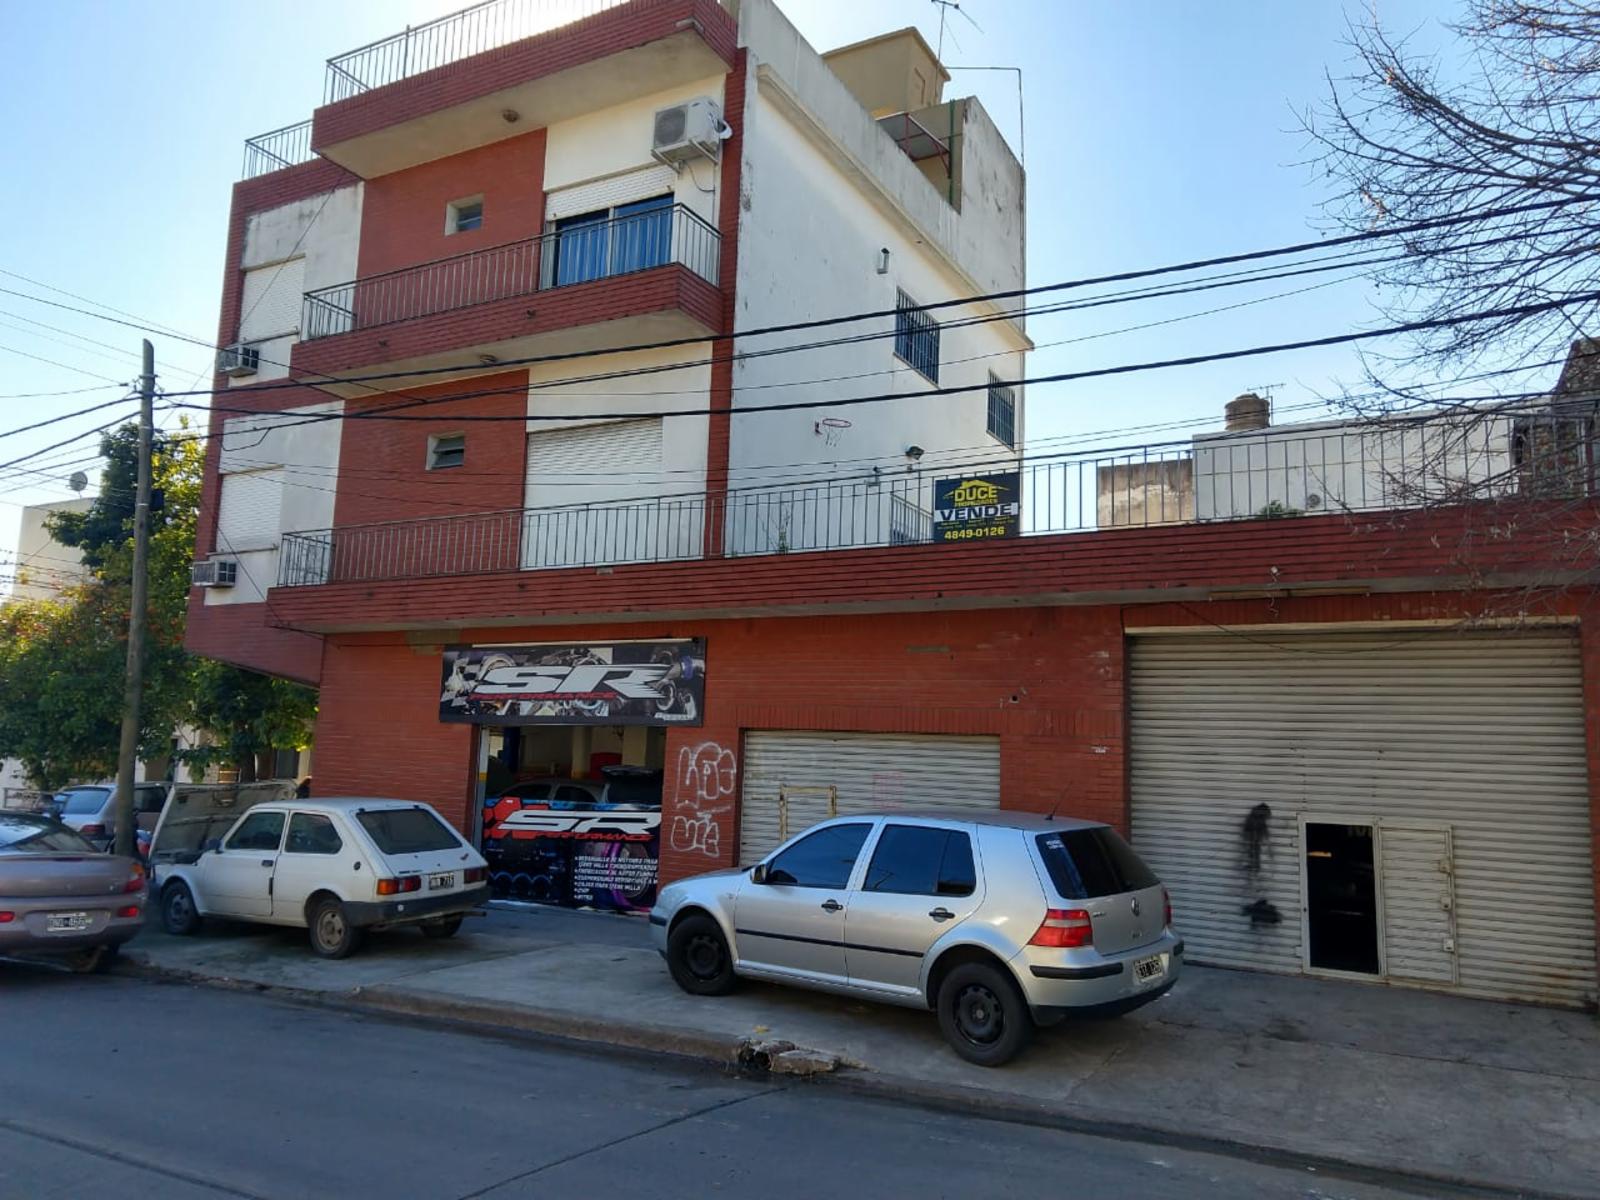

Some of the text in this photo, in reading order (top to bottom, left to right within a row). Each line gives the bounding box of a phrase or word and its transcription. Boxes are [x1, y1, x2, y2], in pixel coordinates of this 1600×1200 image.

[955, 486, 998, 502] DUCE
[940, 504, 1012, 520] VENDE
[945, 527, 1005, 540] 4849-0126
[473, 663, 673, 699] SR
[498, 809, 662, 834] SR
